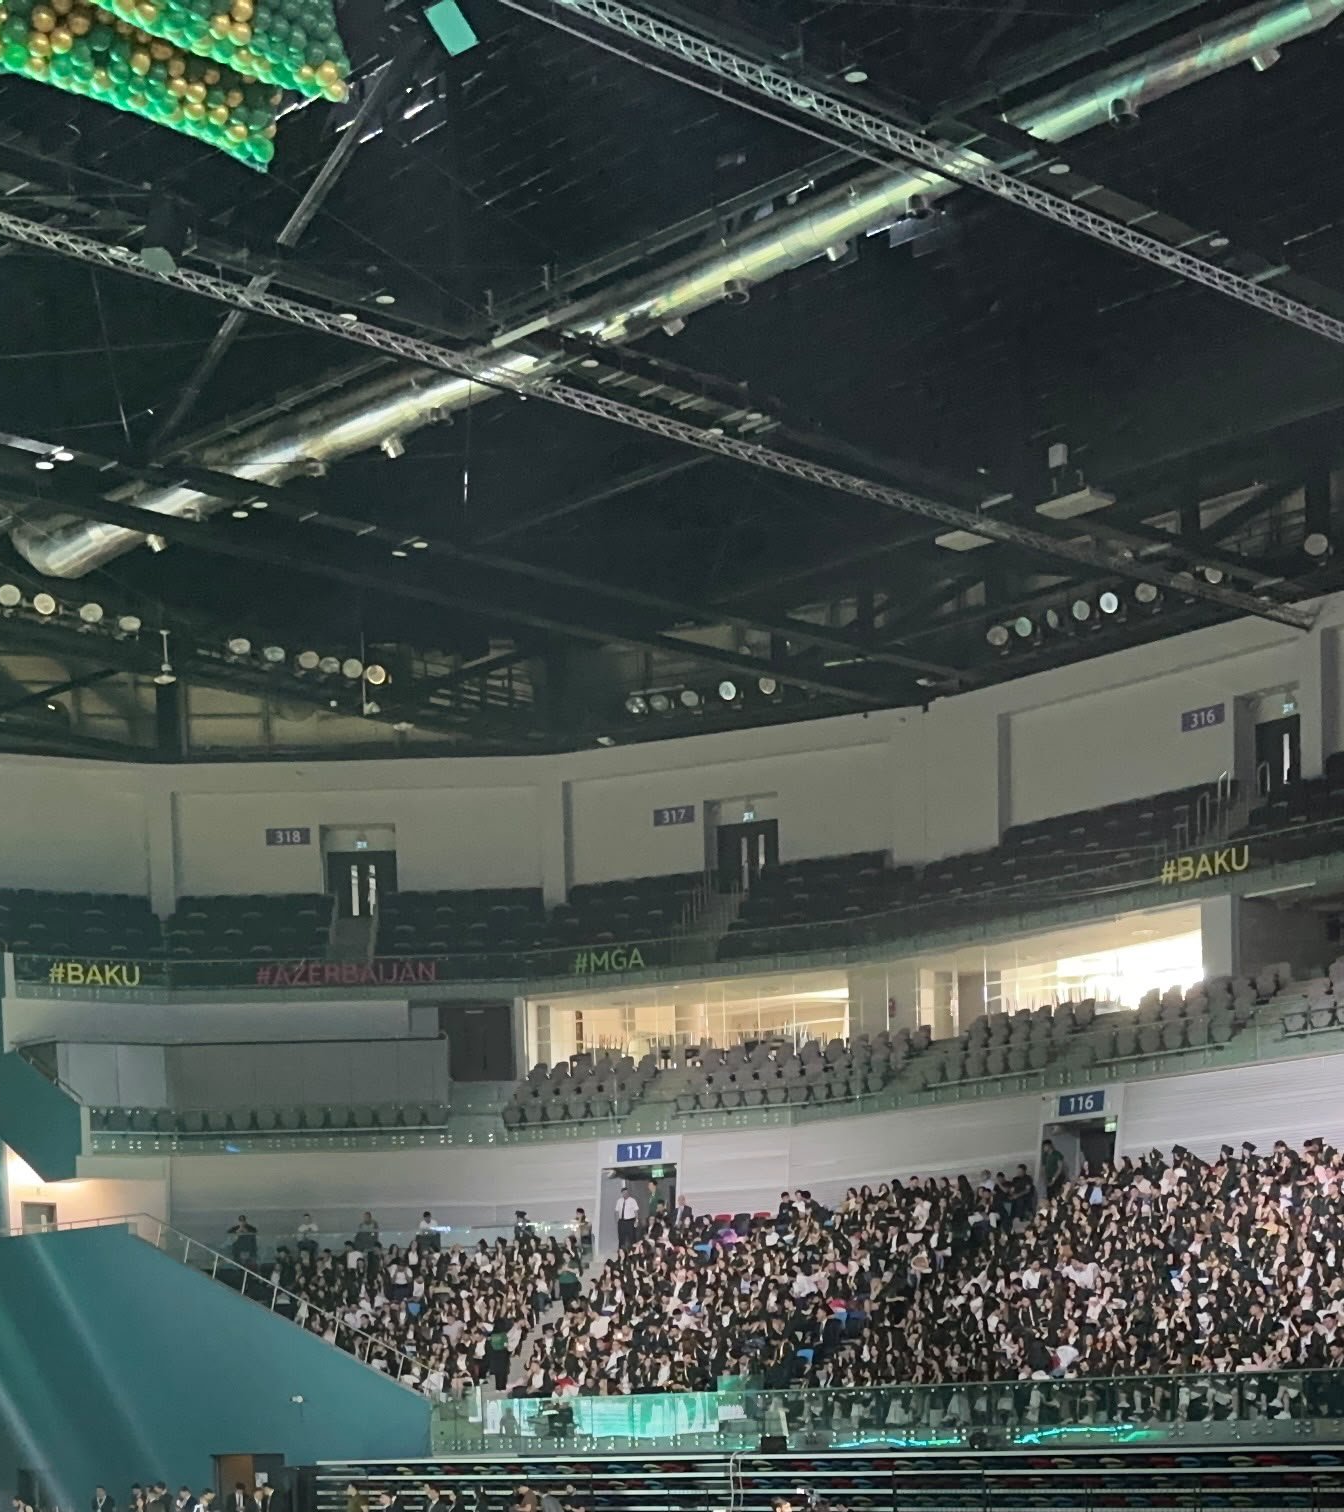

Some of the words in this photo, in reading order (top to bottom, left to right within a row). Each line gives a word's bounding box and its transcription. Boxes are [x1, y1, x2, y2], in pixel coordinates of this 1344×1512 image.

[1190, 709, 1215, 728] 316
[662, 808, 686, 823] 317
[275, 830, 301, 843] 318
[1160, 844, 1250, 884] #BAKU
[574, 947, 645, 975] #MGA
[48, 961, 141, 987] #BAKU
[256, 960, 437, 985] #AZERBAIJAN
[1069, 1095, 1094, 1113] 116
[627, 1144, 652, 1159] 117
